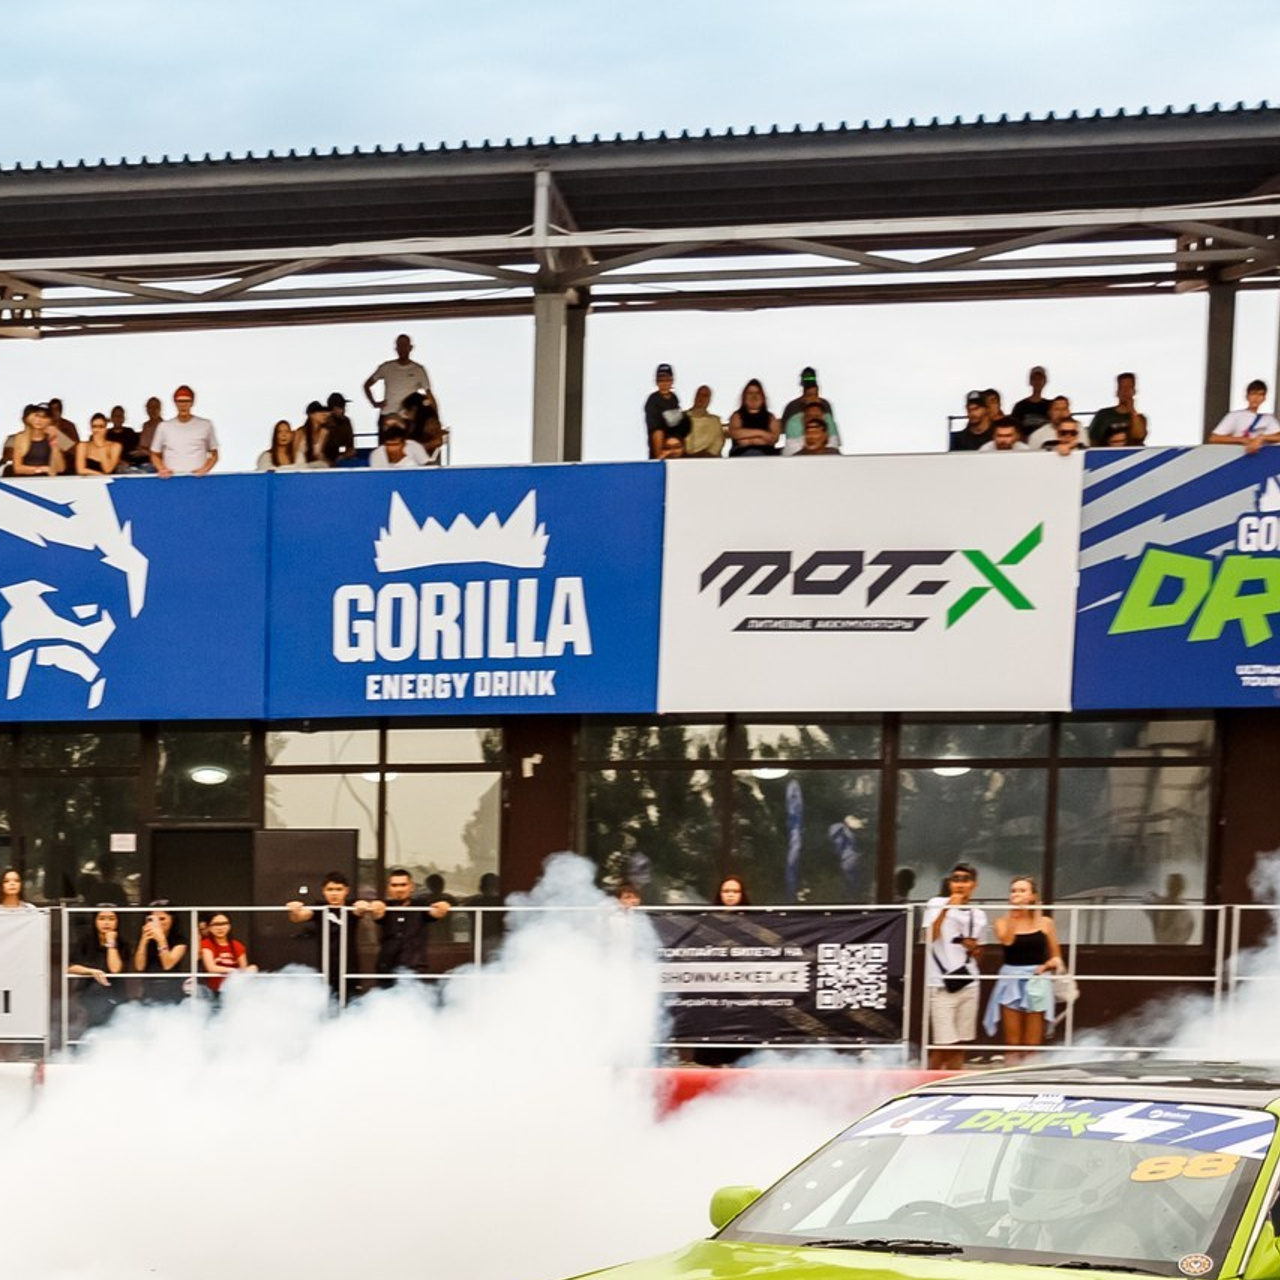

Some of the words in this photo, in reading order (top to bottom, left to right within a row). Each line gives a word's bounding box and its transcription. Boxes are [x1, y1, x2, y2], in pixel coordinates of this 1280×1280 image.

[1237, 515, 1280, 551] GO
[332, 577, 593, 663] GORILLA
[365, 673, 470, 700] ENERGY
[473, 670, 557, 697] DRINK
[955, 1110, 1100, 1138] DRIFT
[1130, 1153, 1241, 1183] 88
